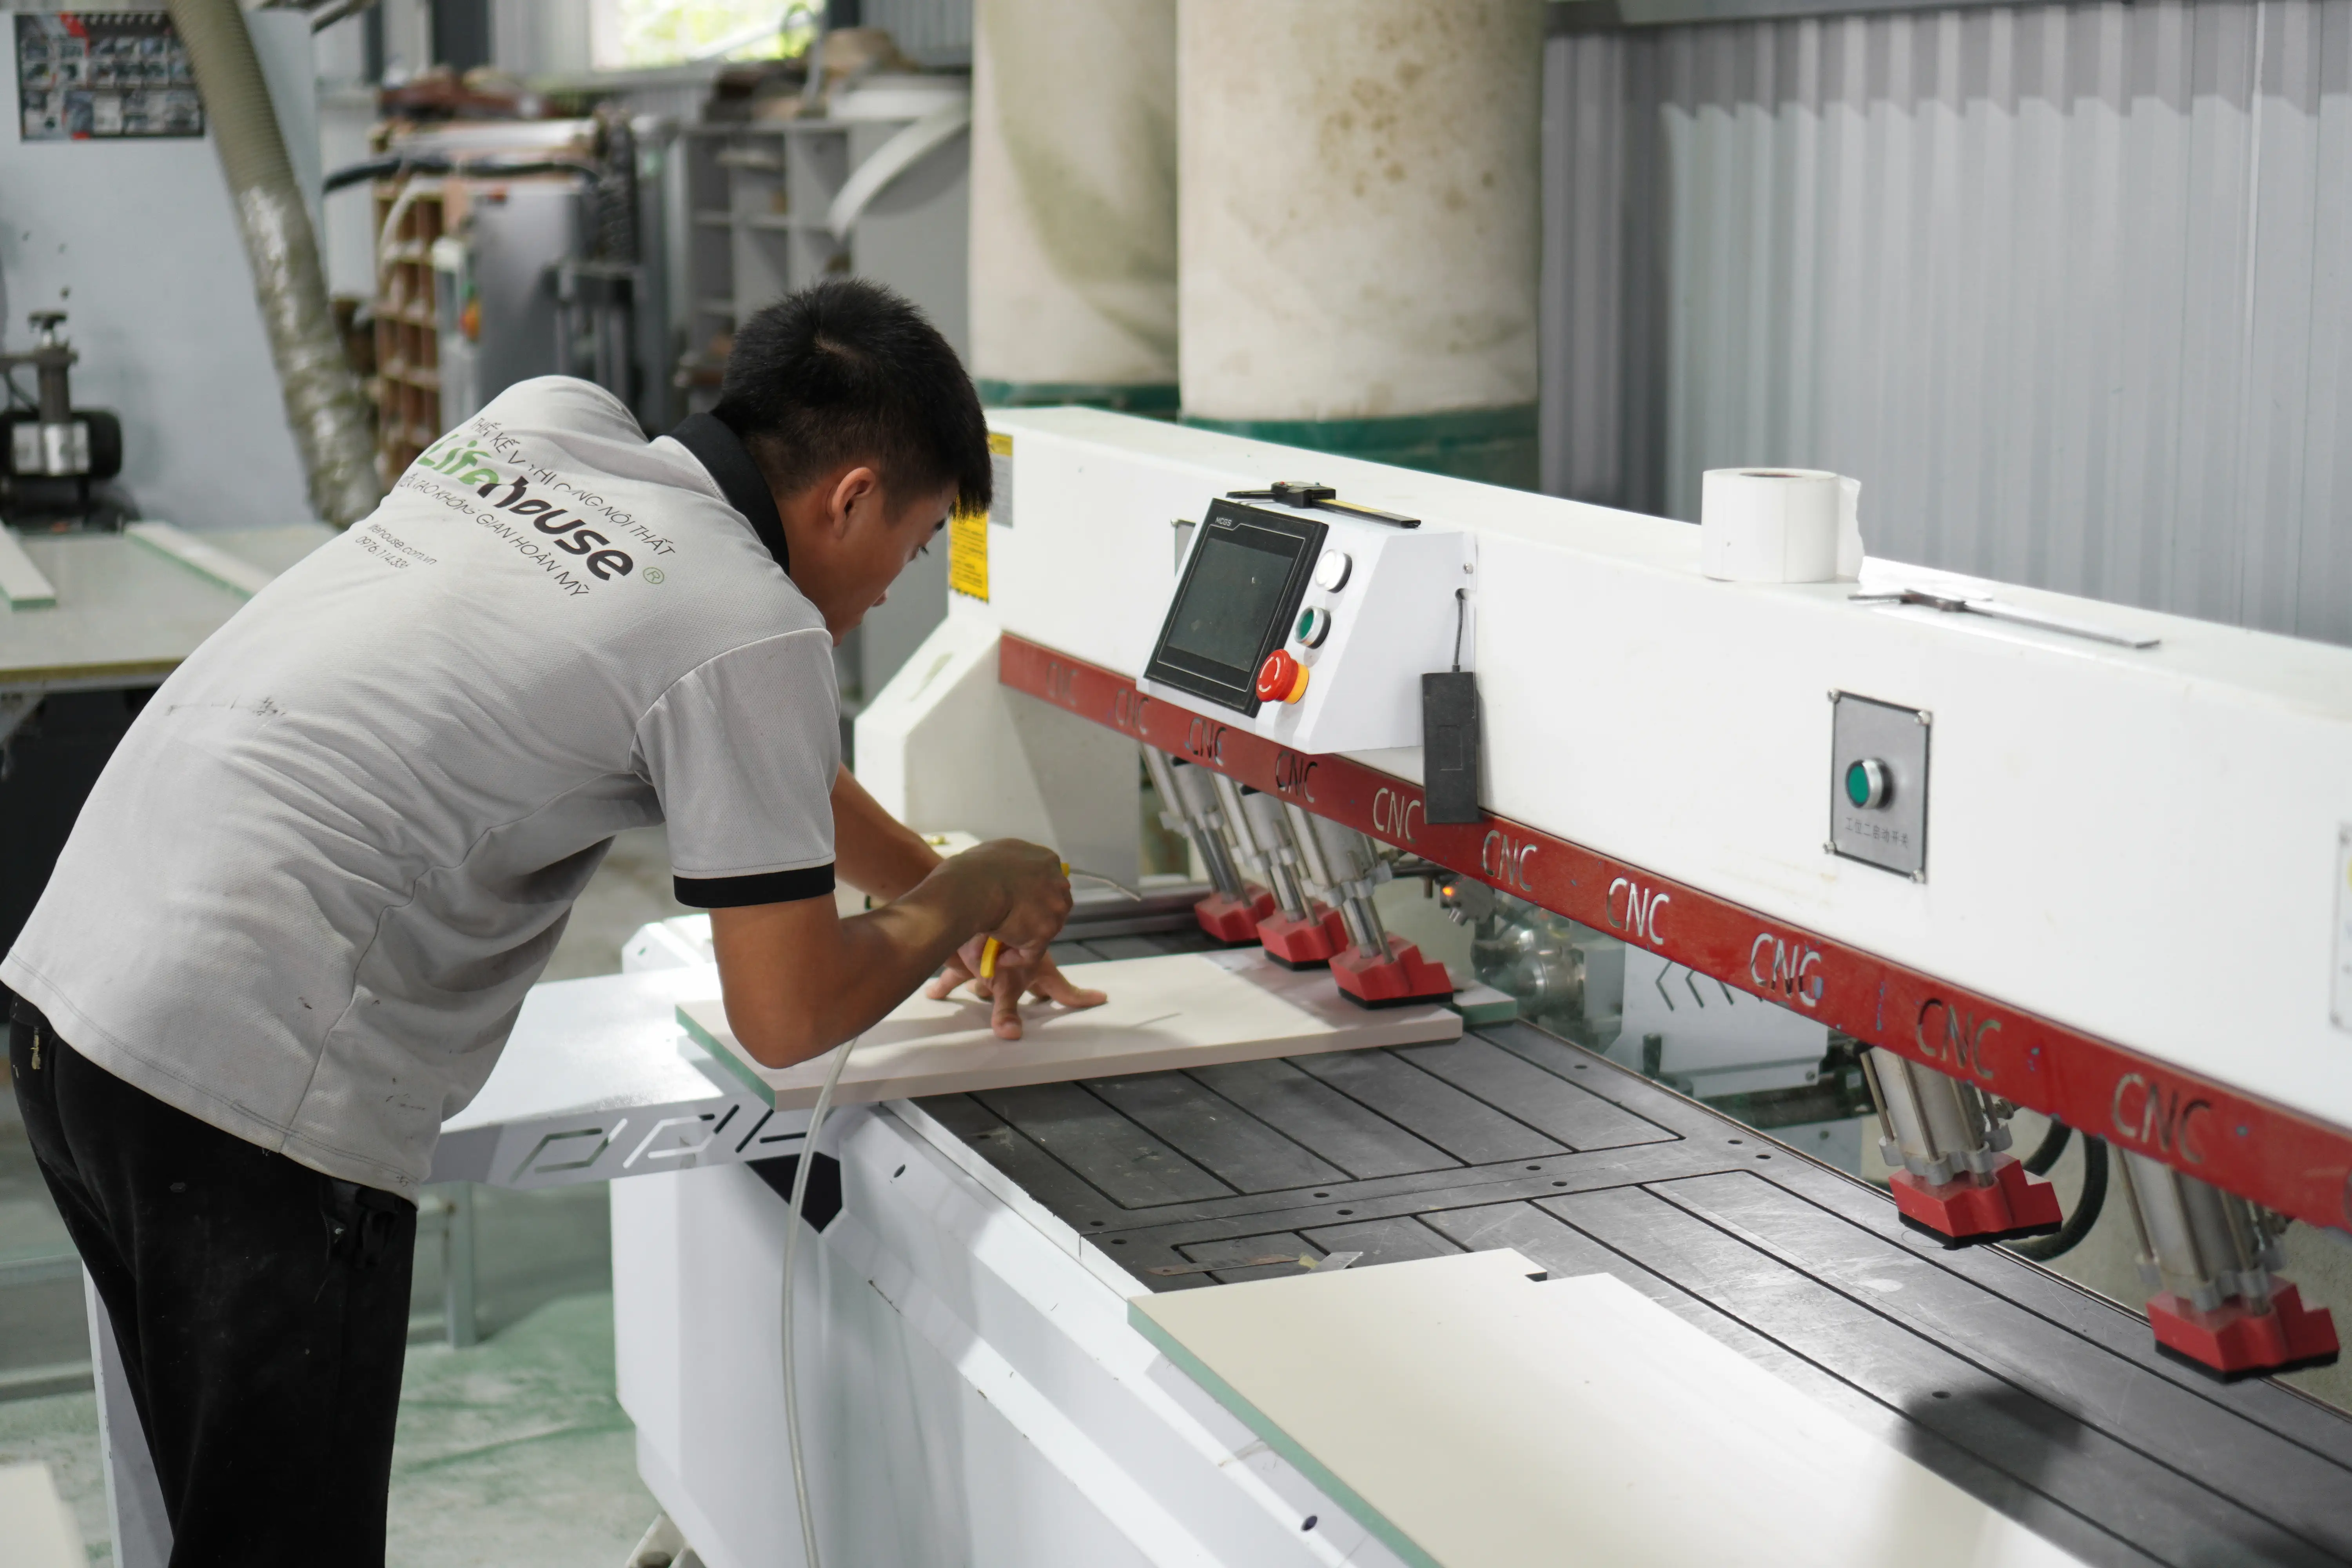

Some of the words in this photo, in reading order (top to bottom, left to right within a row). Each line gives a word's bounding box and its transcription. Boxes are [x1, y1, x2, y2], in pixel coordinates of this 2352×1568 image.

[476, 514, 517, 538] GIAN
[509, 536, 562, 572] HOÀN
[597, 506, 635, 527] NỘI
[629, 525, 676, 555] THẤT
[1215, 517, 1232, 526] MCGS
[1047, 662, 1078, 706] CNC
[1115, 688, 1149, 735] CNC
[1189, 717, 1227, 766] CNC
[1276, 750, 1318, 803] CNC
[1373, 788, 1421, 843] CNC
[1482, 830, 1536, 892] CNC
[1606, 878, 1670, 945] CNC
[1915, 998, 2001, 1079] CNC
[2112, 1073, 2212, 1165] CNC
